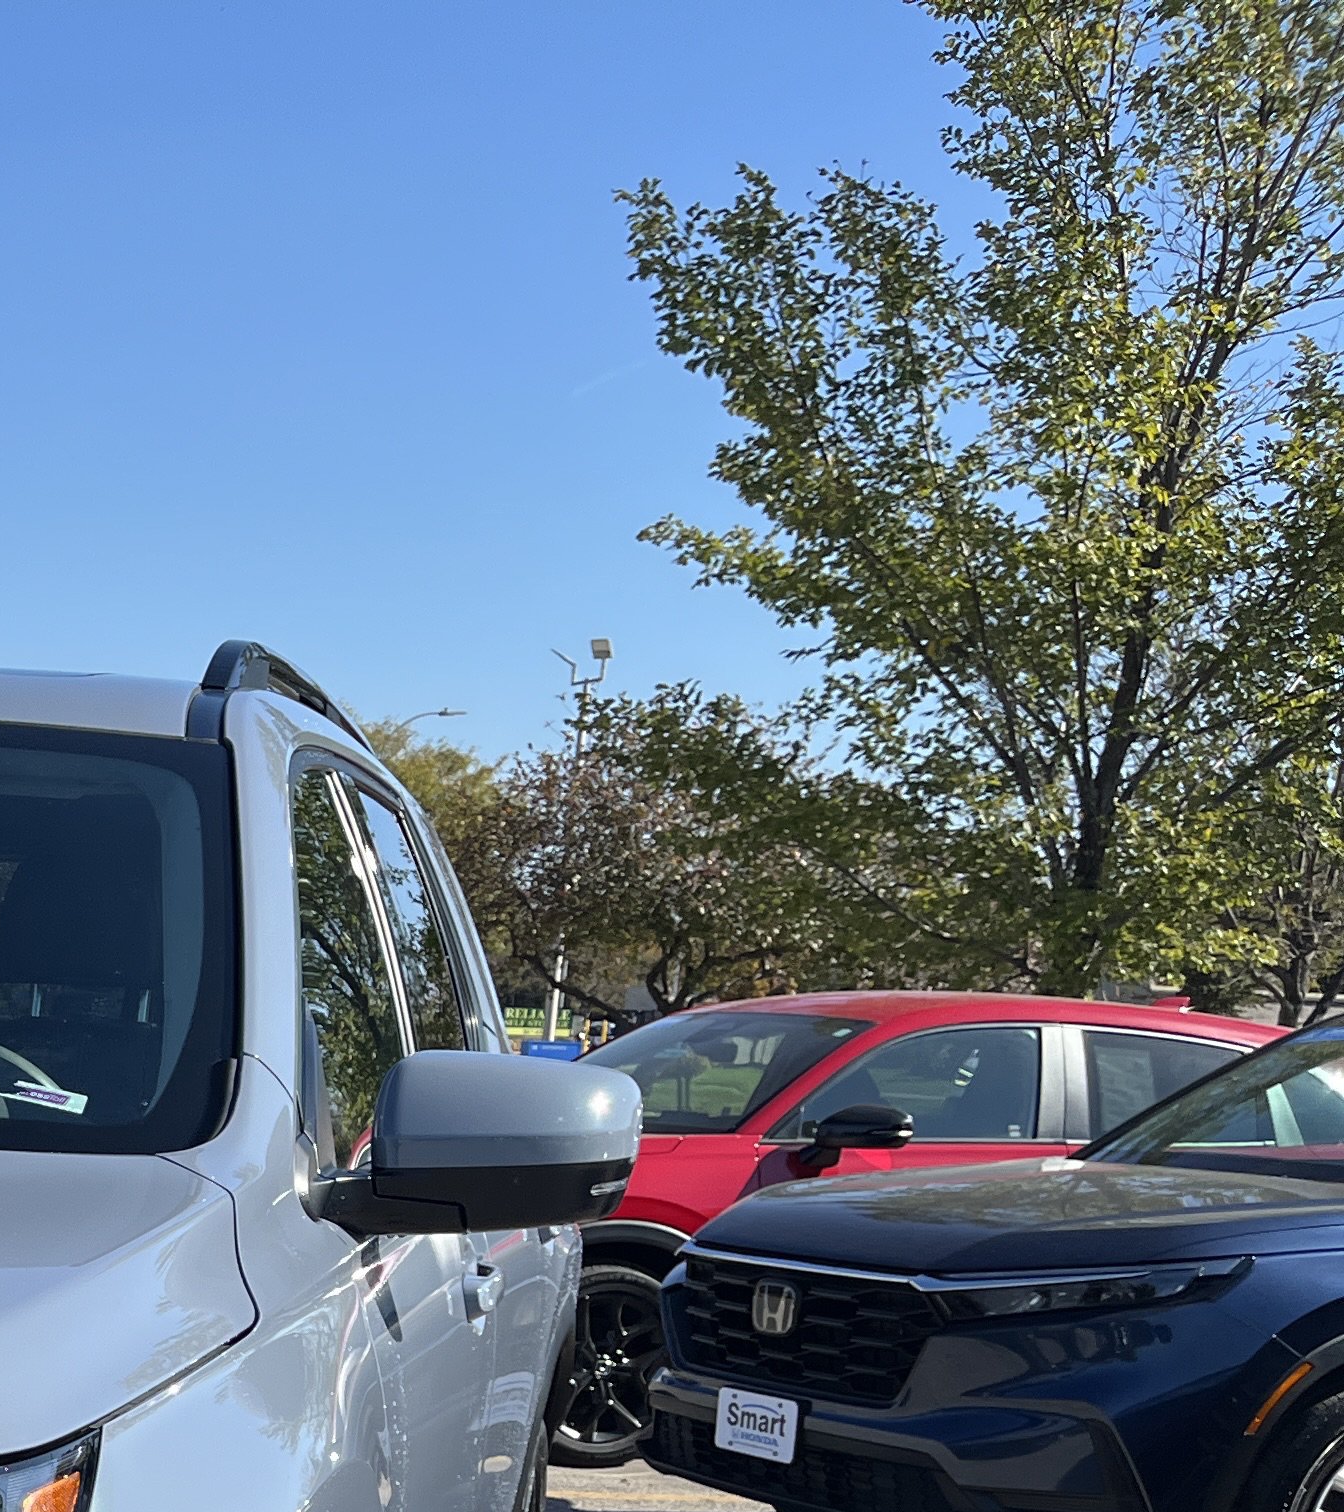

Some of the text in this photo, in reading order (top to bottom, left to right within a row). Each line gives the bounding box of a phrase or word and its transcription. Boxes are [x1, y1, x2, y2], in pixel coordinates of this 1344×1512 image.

[505, 1007, 571, 1020] RELIAE
[727, 1402, 786, 1438] Smart
[740, 1431, 779, 1447] HONDA
